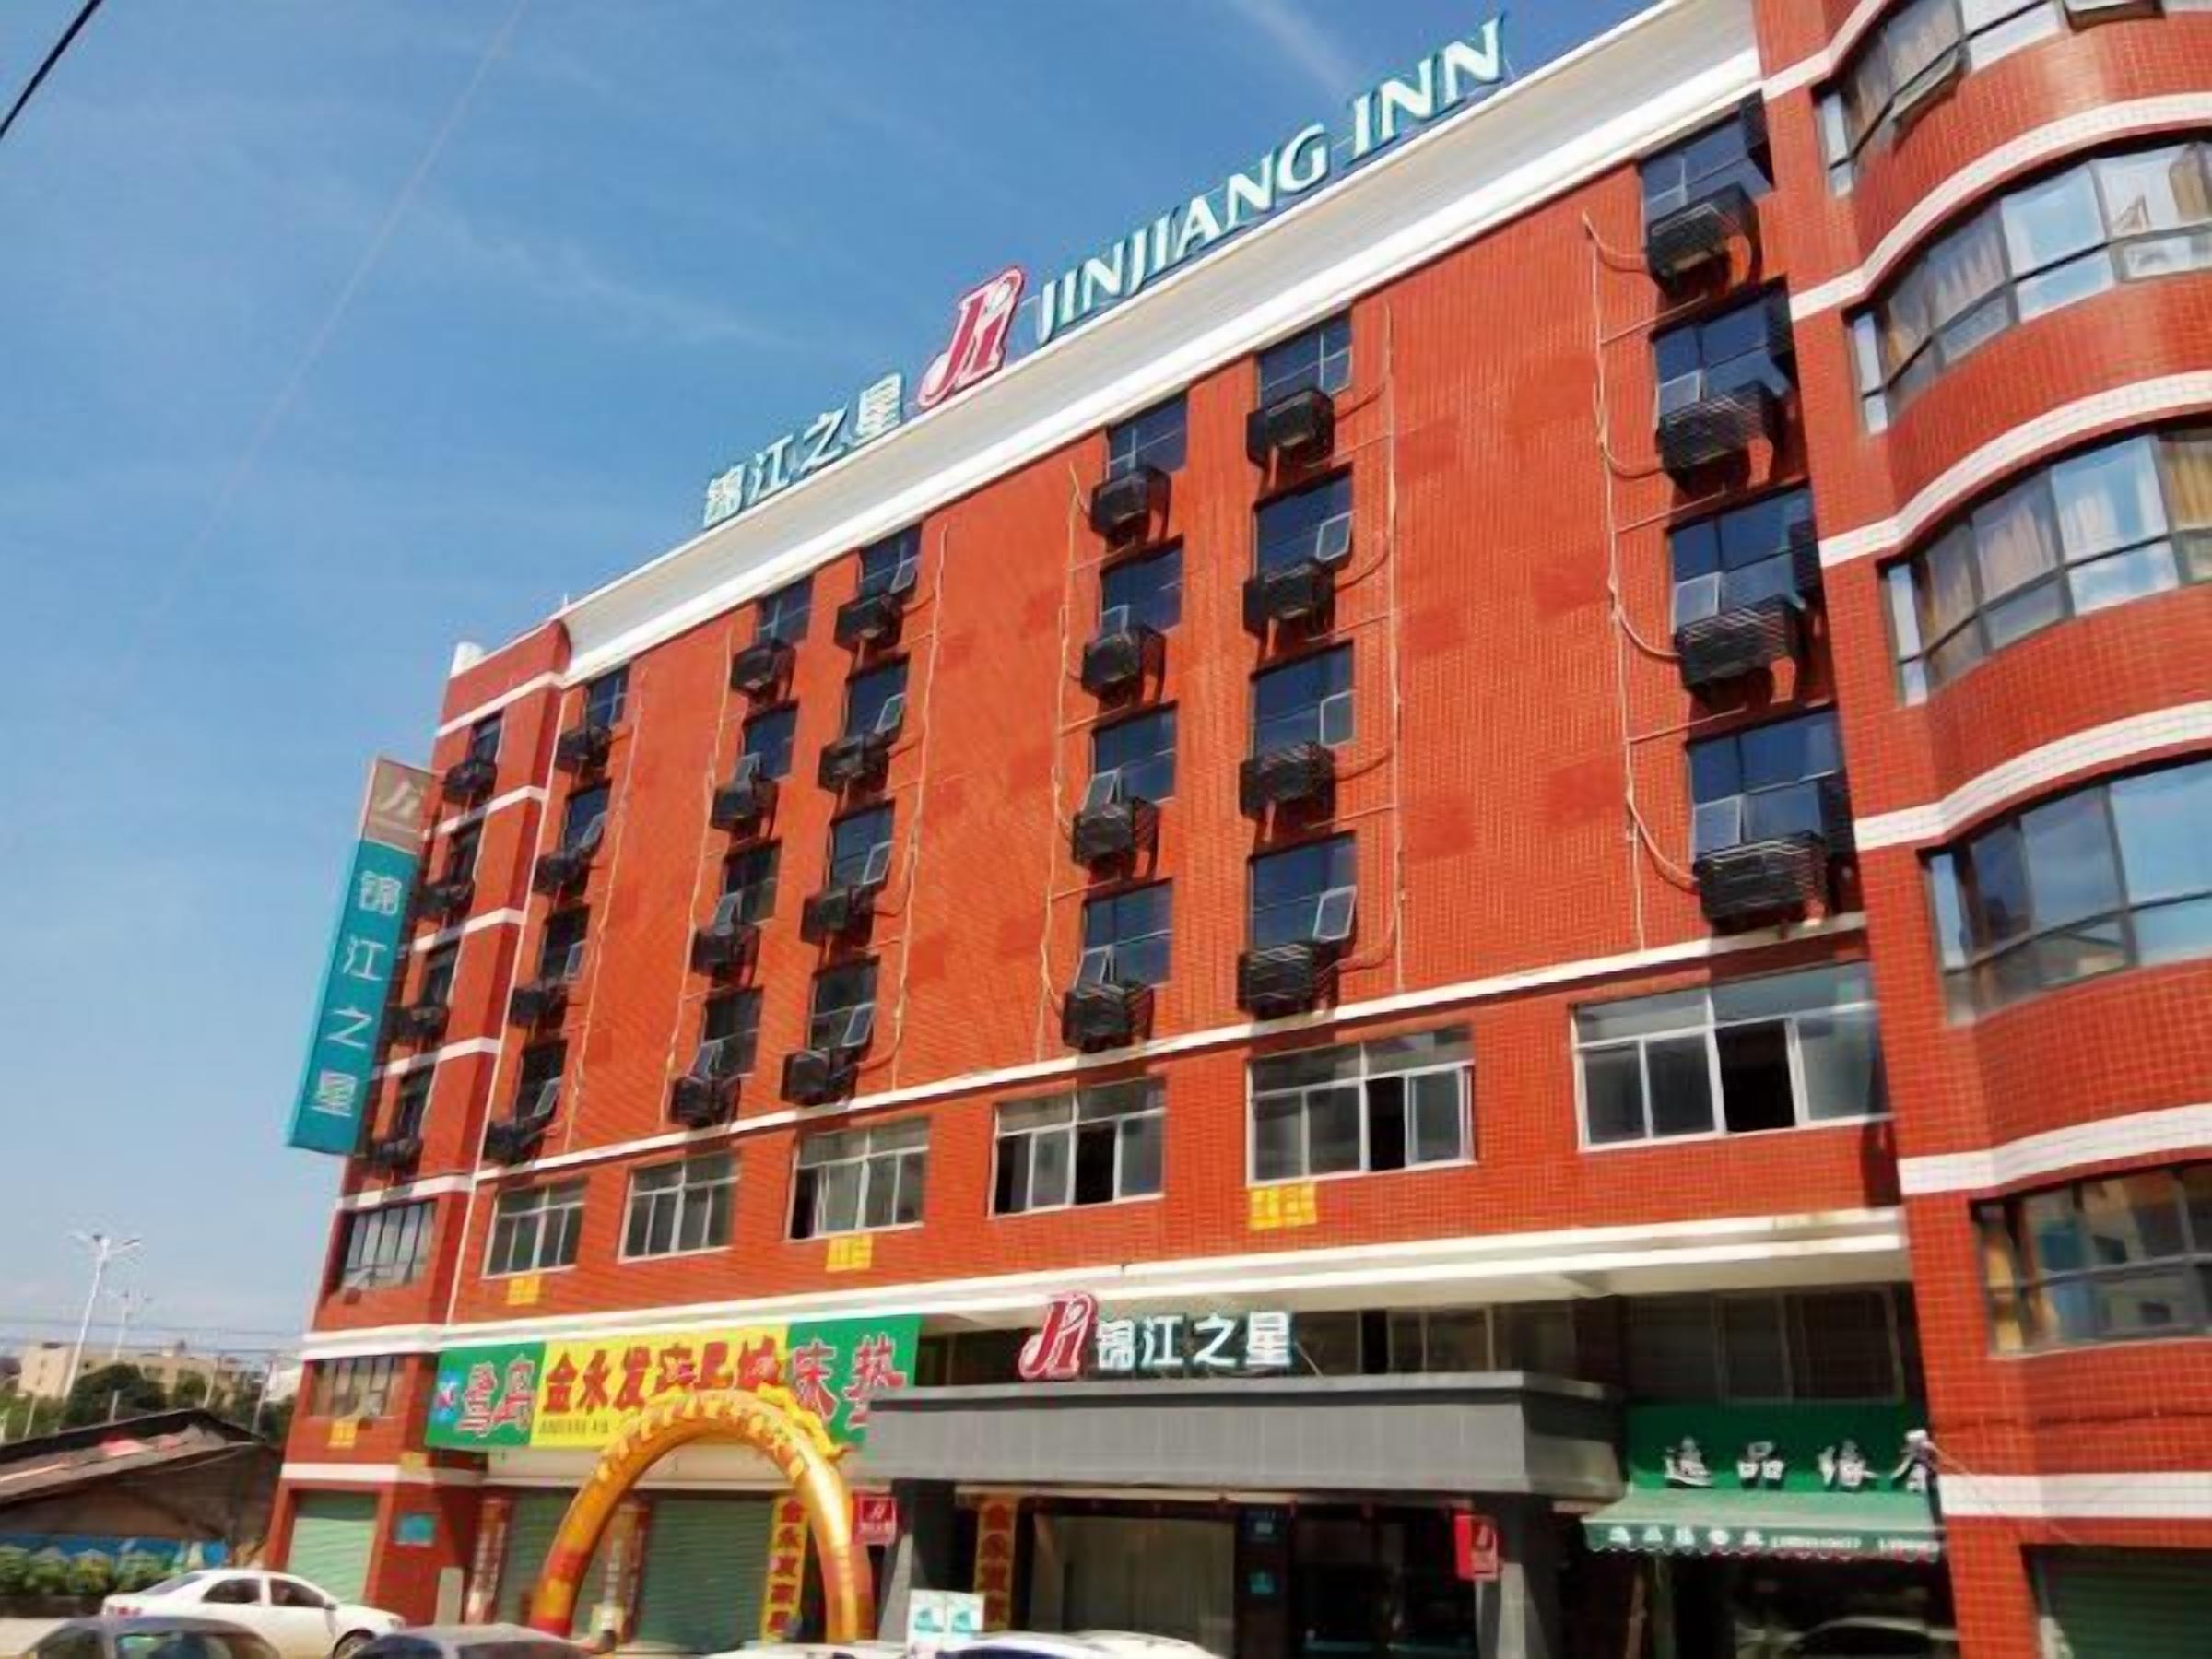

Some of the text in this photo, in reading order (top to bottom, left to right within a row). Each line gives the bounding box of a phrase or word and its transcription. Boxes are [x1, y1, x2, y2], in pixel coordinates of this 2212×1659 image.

[1036, 12, 1507, 347] JINJIANG INN
[702, 371, 905, 529] 锦江之星
[1096, 1311, 1292, 1371] 锦江之星
